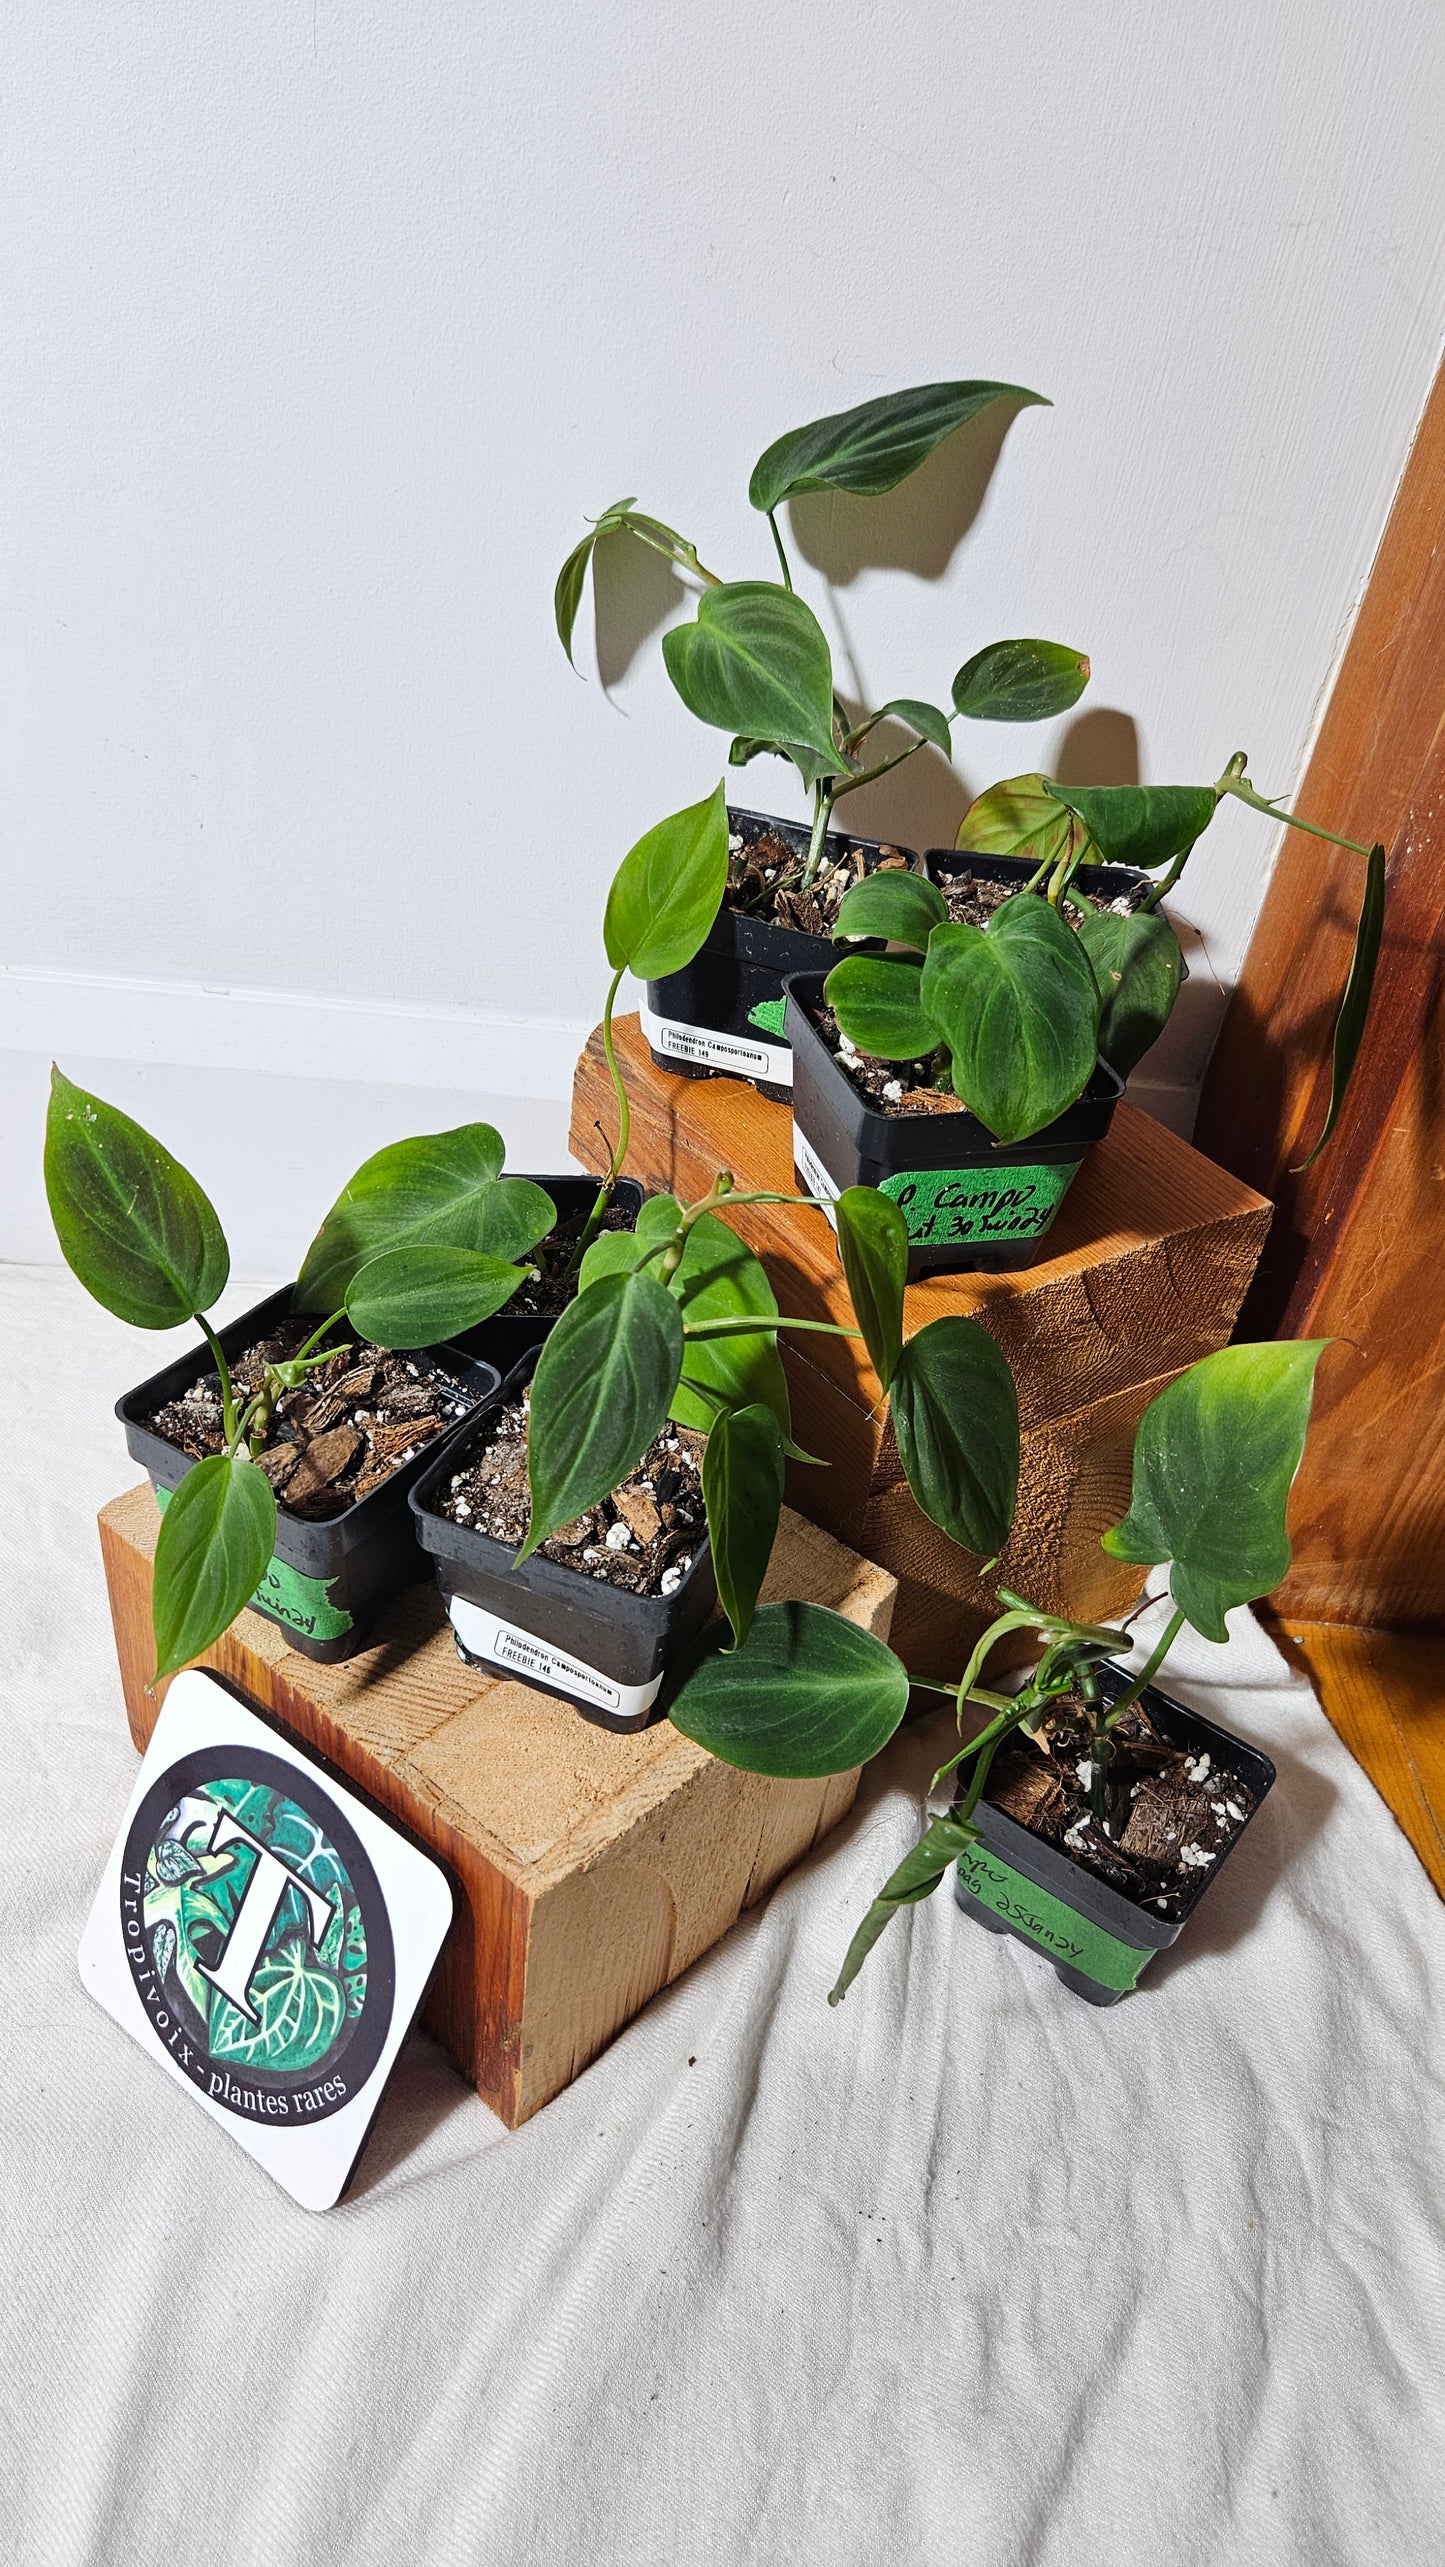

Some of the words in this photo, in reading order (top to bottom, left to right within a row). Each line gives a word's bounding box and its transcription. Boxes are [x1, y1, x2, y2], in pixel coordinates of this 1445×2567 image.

[667, 1041, 696, 1055] FREEBIE
[668, 1030, 706, 1047] Philodendron
[934, 1183, 1037, 1217] Campo
[502, 1647, 536, 1668] FREEBIE
[505, 1634, 549, 1661] Philodendron
[122, 1872, 196, 2068] Tropivoix
[208, 2070, 289, 2116] plantes
[293, 2071, 349, 2114] rares
